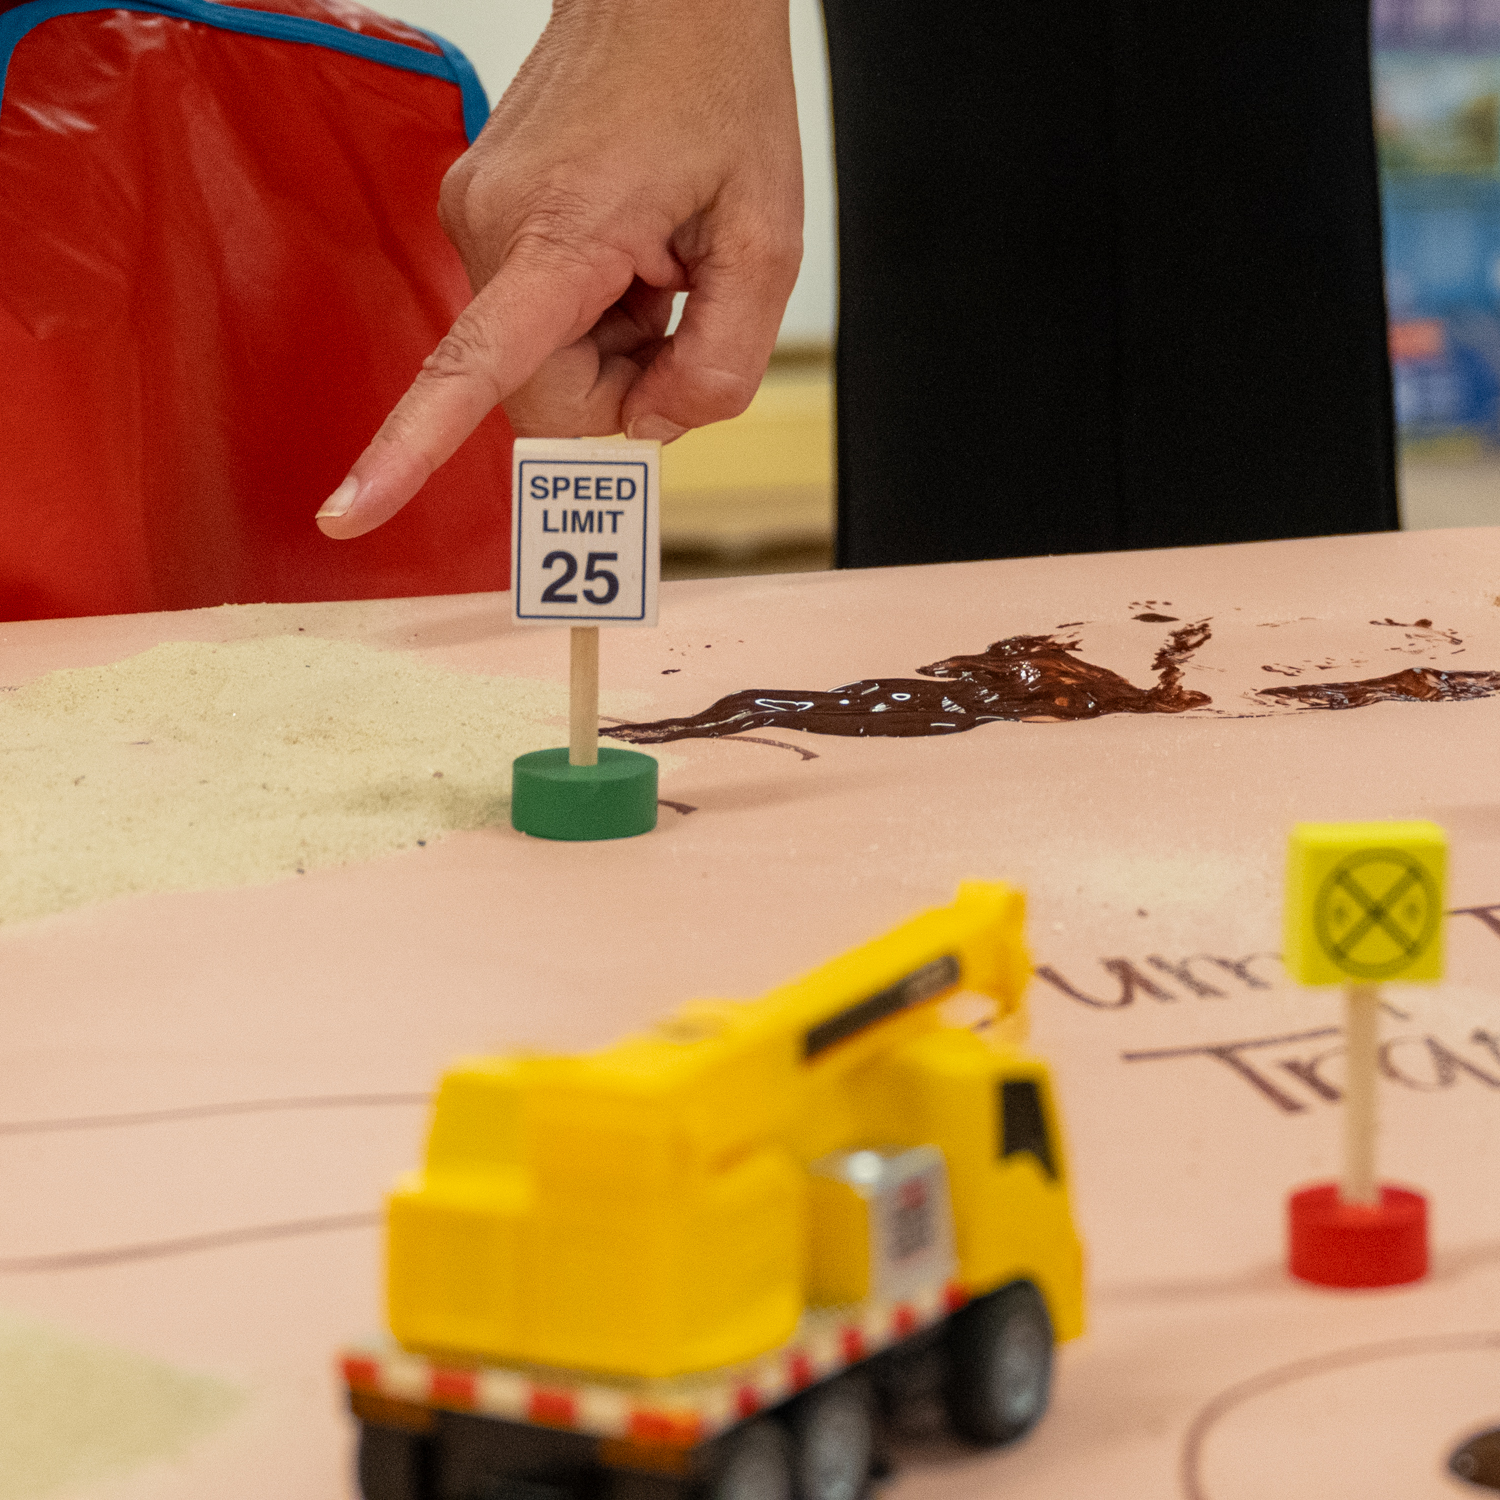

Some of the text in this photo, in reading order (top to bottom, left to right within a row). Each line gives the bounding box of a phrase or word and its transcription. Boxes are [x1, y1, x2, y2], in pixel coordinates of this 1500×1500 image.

[529, 475, 638, 501] SPEED
[541, 509, 625, 534] LIMIT
[540, 550, 620, 605] 25
